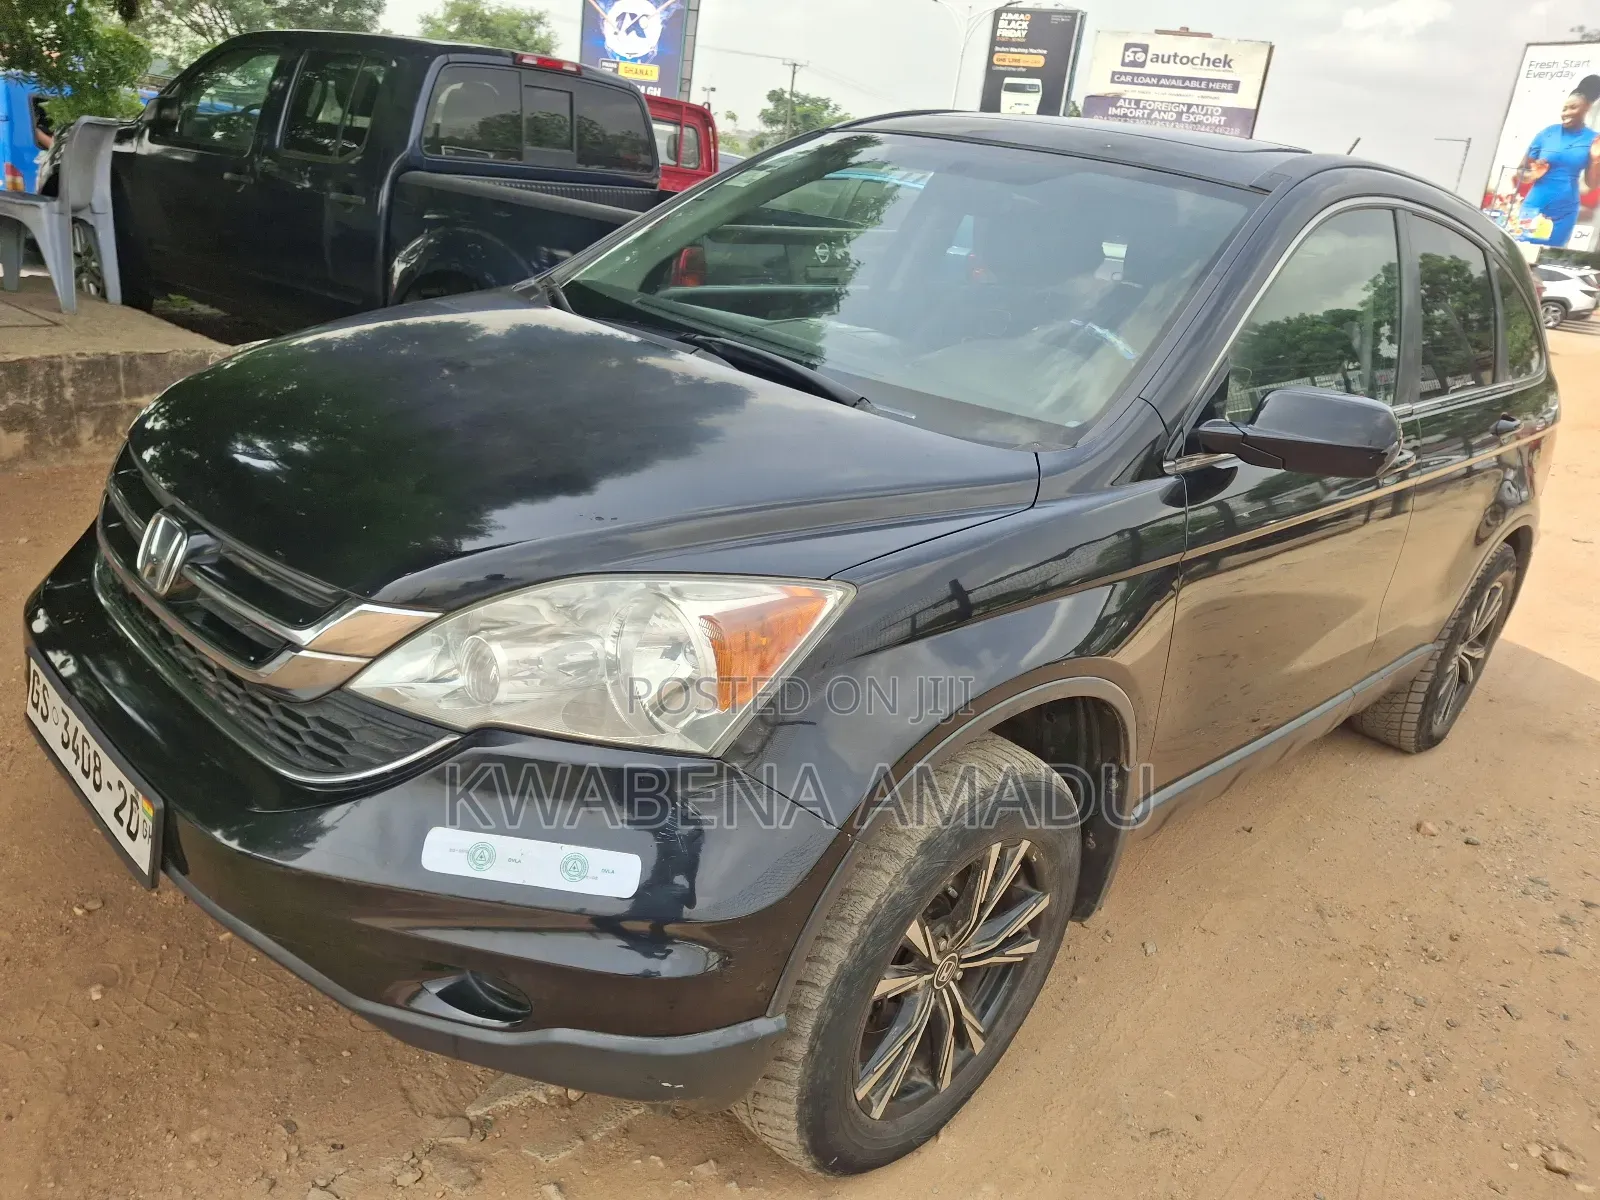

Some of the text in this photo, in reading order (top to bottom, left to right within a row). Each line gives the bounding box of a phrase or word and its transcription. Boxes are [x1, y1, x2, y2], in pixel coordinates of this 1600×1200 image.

[997, 29, 1027, 37] FRIDAY
[998, 20, 1029, 29] BLACK
[1150, 52, 1234, 69] autochek
[1528, 59, 1590, 69] Fresh Start
[1114, 74, 1233, 91] CAR LOAN AVAILABLE HERE
[1525, 69, 1577, 80] Everyday
[1116, 98, 1222, 115] ALL FOREIGN AUTO
[1108, 107, 1151, 118] IMPORT
[1151, 111, 1176, 121] AND
[1181, 113, 1227, 125] EXPORT
[31, 671, 50, 724] GS
